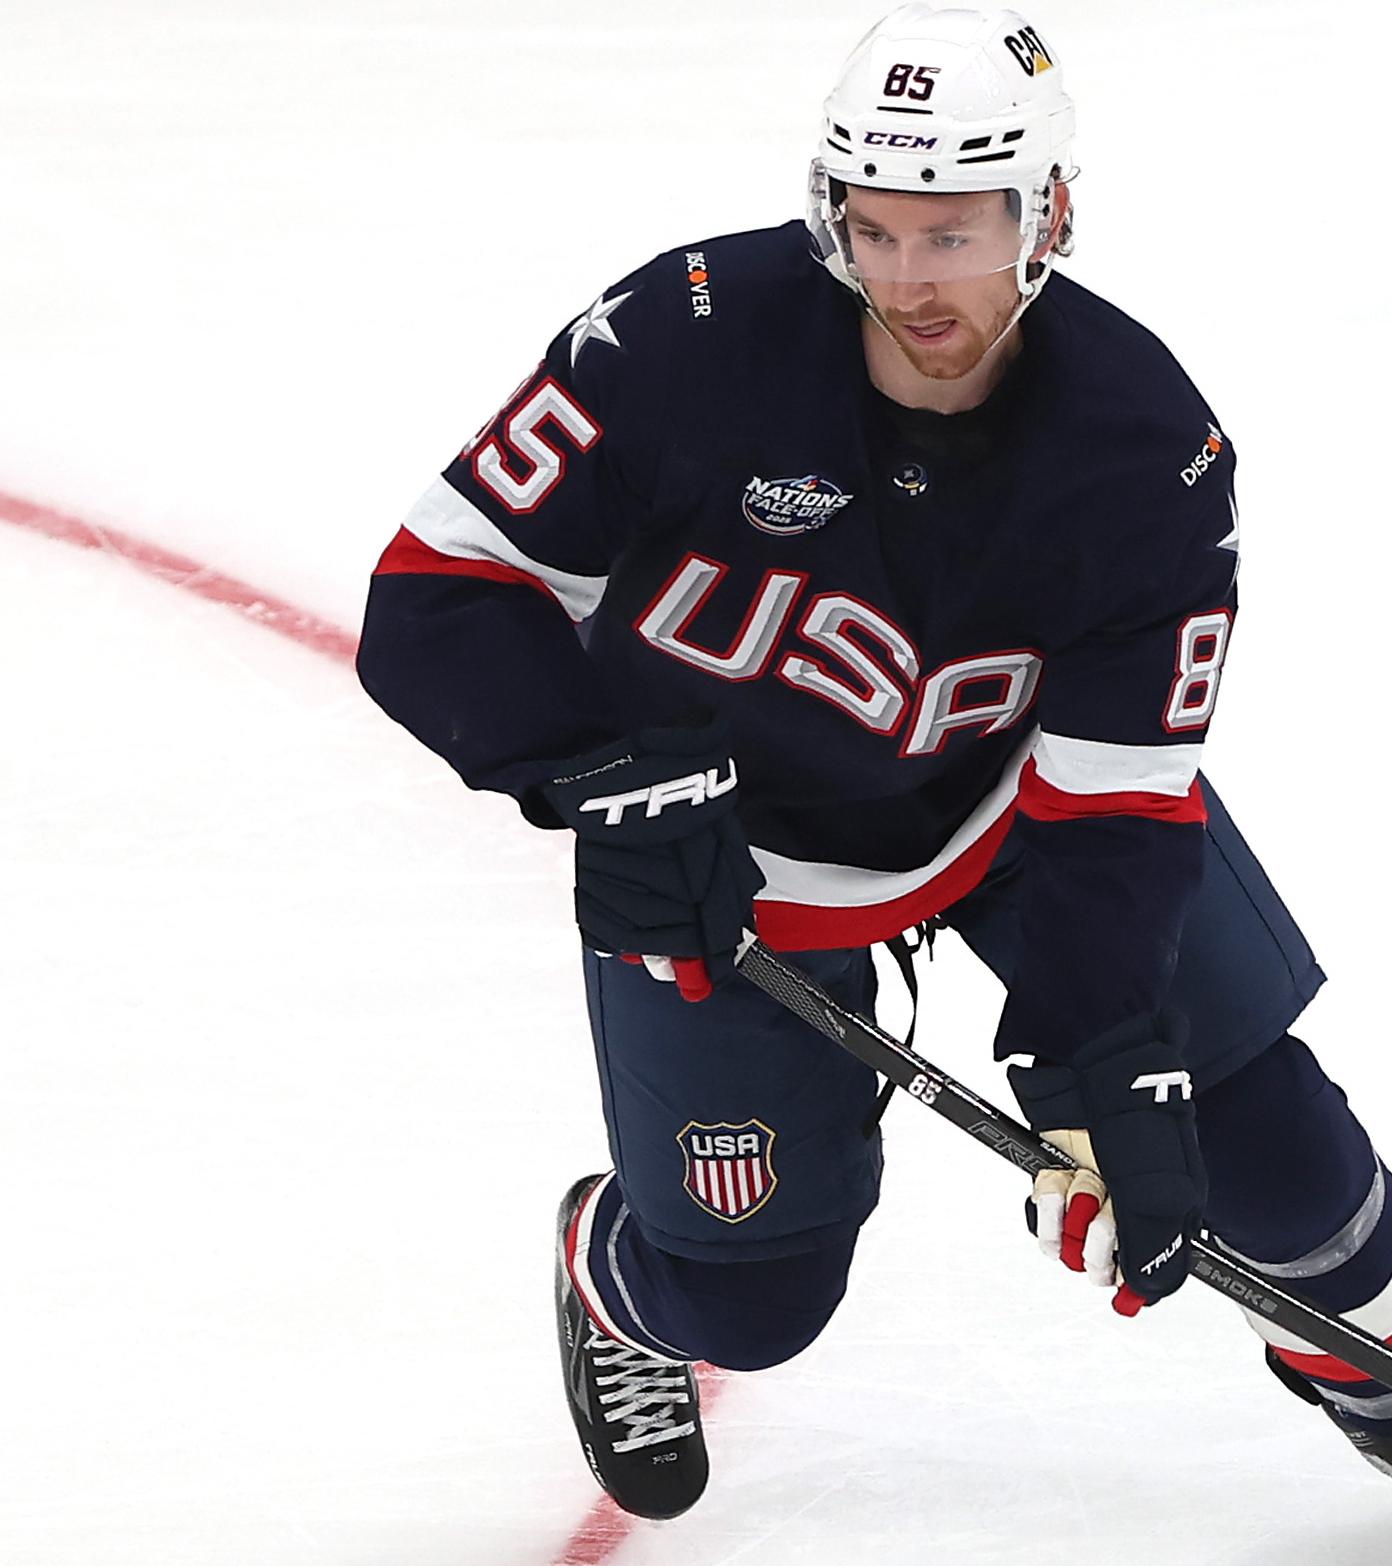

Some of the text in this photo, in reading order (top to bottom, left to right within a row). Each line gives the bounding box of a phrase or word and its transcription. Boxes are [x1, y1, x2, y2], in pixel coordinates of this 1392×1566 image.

[1003, 25, 1053, 77] CAT
[883, 63, 941, 101] 85
[863, 131, 938, 150] CCM
[460, 359, 604, 515] 5
[745, 476, 854, 508] NATIONS
[747, 493, 835, 518] FACE-OFF
[633, 551, 1046, 758] USA
[1161, 606, 1234, 734] 8
[579, 757, 738, 826] TRU
[908, 1073, 942, 1104] 85
[691, 1133, 760, 1156] USA
[1140, 1233, 1183, 1275] TRUE
